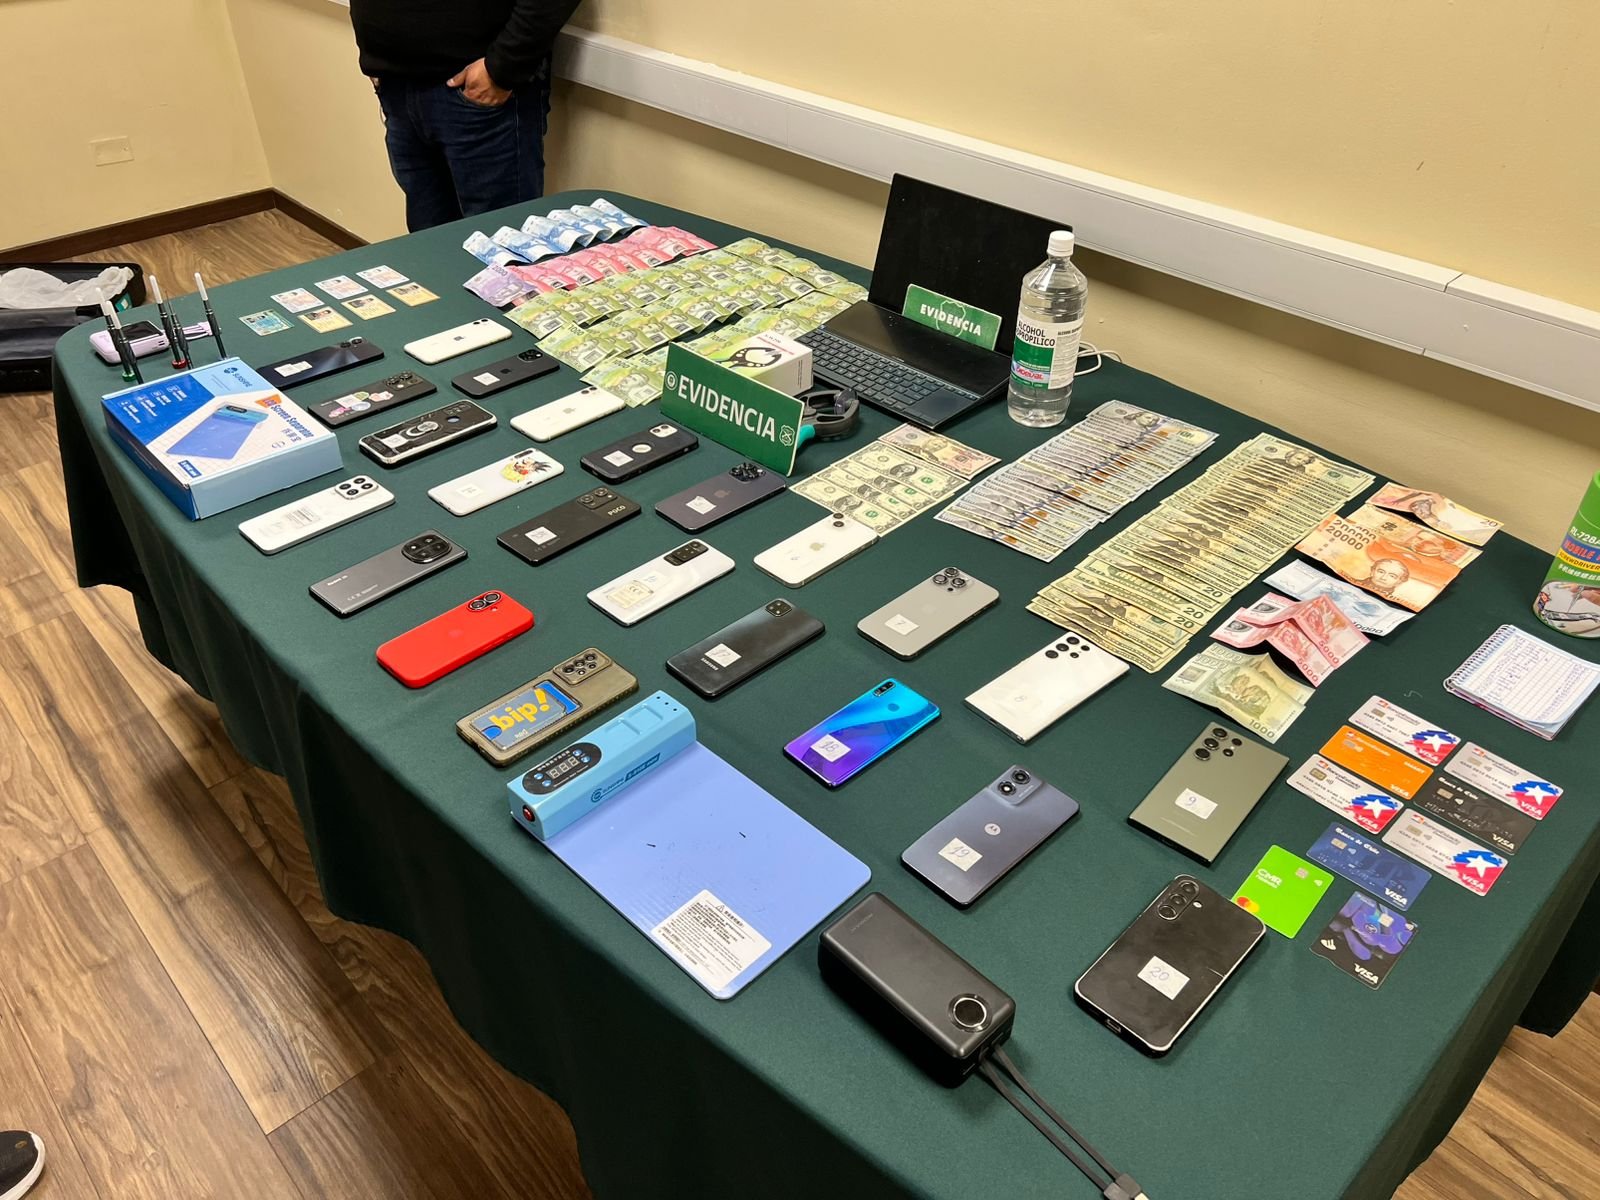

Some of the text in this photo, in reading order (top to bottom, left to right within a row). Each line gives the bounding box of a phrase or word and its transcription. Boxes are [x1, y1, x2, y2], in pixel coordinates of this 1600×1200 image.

[920, 303, 981, 336] EVIDENCIA
[568, 324, 585, 336] 1000
[1018, 320, 1046, 338] ALCOHOL
[677, 375, 776, 442] EVIDENCIA
[607, 504, 626, 516] POCO
[1326, 525, 1364, 550] 20000
[1203, 586, 1224, 598] 20
[1183, 607, 1205, 620] 20
[1173, 616, 1195, 630] 20
[1318, 640, 1340, 665] 5000
[1298, 657, 1319, 683] 5000
[488, 688, 550, 731] bip!
[1249, 718, 1275, 739] 1000
[1419, 749, 1439, 762] VISA
[1390, 784, 1409, 797] VISA
[1520, 801, 1543, 816] VISA
[1357, 815, 1379, 829] VISA
[1492, 833, 1515, 850] VISA
[1462, 873, 1485, 890] VISA
[1385, 887, 1408, 905] VISA
[1150, 966, 1170, 981] 20
[1354, 963, 1379, 984] VISA
